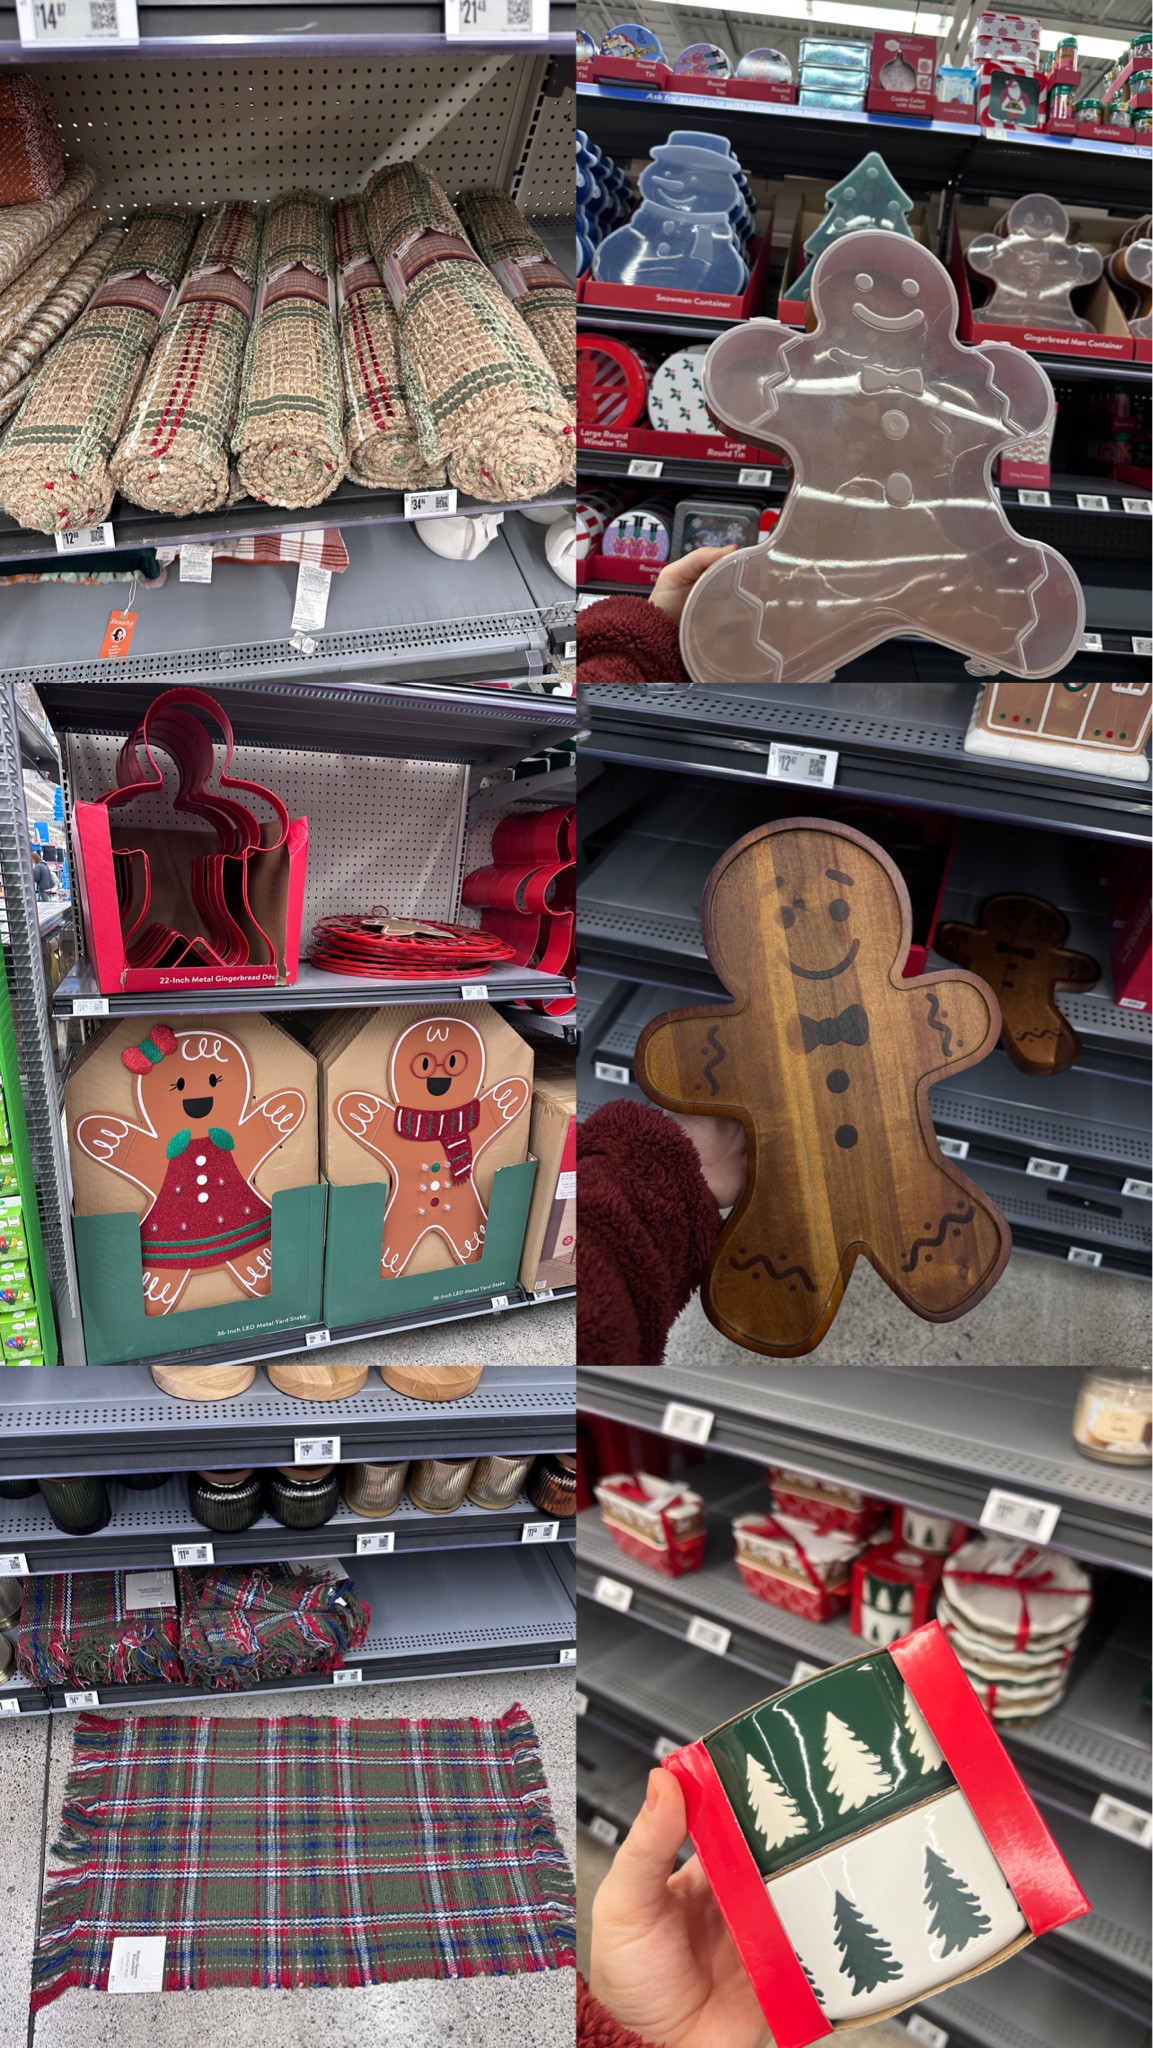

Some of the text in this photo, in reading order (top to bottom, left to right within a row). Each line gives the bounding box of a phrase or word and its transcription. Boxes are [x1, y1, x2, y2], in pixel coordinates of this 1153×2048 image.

[636, 62, 656, 70] Round
[646, 92, 663, 100] Ask
[1094, 127, 1120, 136] Sprinkles
[656, 293, 731, 308] Snowman Container
[1024, 333, 1123, 350] Gingerbread Man Container
[580, 428, 629, 440] Large Round
[584, 438, 628, 448] Window Tin
[725, 441, 747, 450] Large
[707, 448, 746, 458] Round Tin
[159, 976, 190, 984] 22-Inch
[191, 975, 214, 983] Metal
[215, 973, 261, 983] Gingerbread
[216, 1328, 241, 1337] 36-Inch
[242, 1324, 256, 1332] LED
[290, 1314, 306, 1322] Stake
